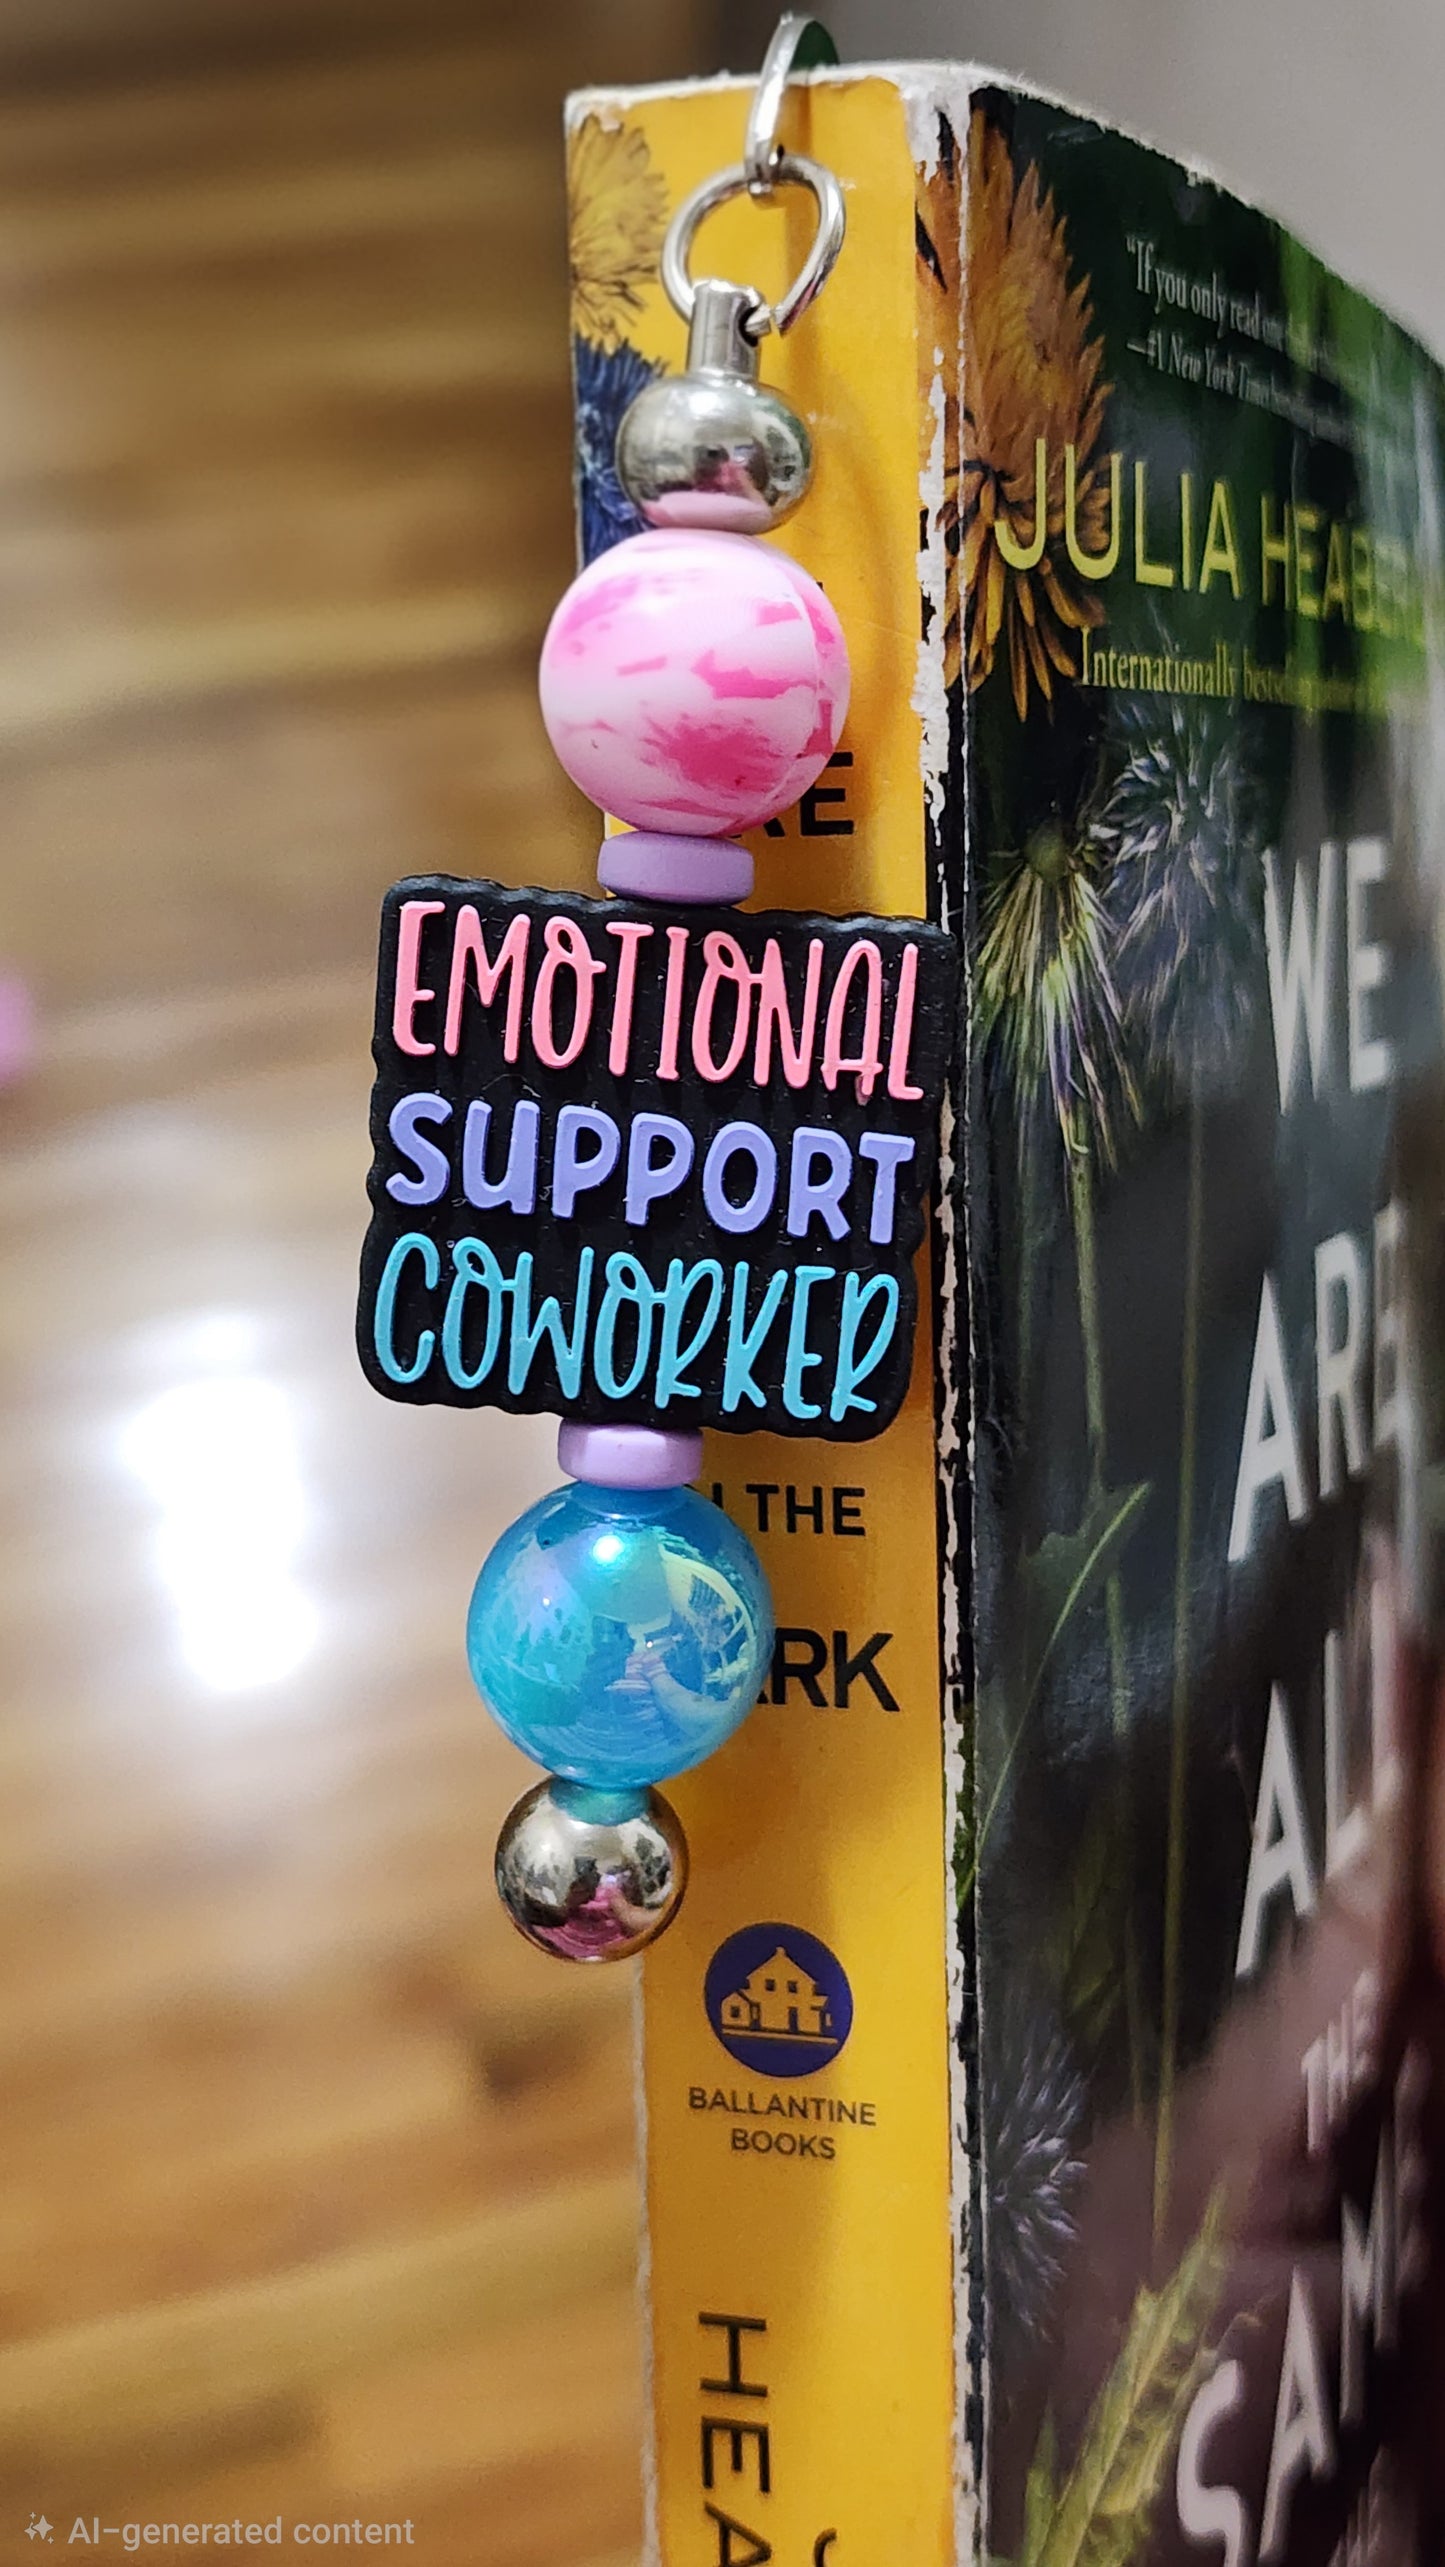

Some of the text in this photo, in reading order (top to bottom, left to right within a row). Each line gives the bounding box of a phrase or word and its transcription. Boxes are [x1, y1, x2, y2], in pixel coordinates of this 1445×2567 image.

[1154, 268, 1187, 315] you
[1191, 272, 1227, 339] only
[1230, 290, 1261, 341] read
[1168, 332, 1202, 383] New
[1205, 345, 1235, 395] York
[994, 437, 1240, 600] JULIA
[1080, 625, 1238, 698] Internationally
[391, 900, 925, 1102] EMOTIONAL
[1263, 837, 1390, 1117] WE
[385, 1092, 916, 1244] SUPPORT
[373, 1232, 900, 1423] COWORKER
[1227, 1198, 1404, 1563] ARE
[746, 1482, 867, 1537] THE
[756, 1627, 901, 1713] RK
[688, 2086, 877, 2126] BALLANTINE
[731, 2127, 837, 2161] BOOKS
